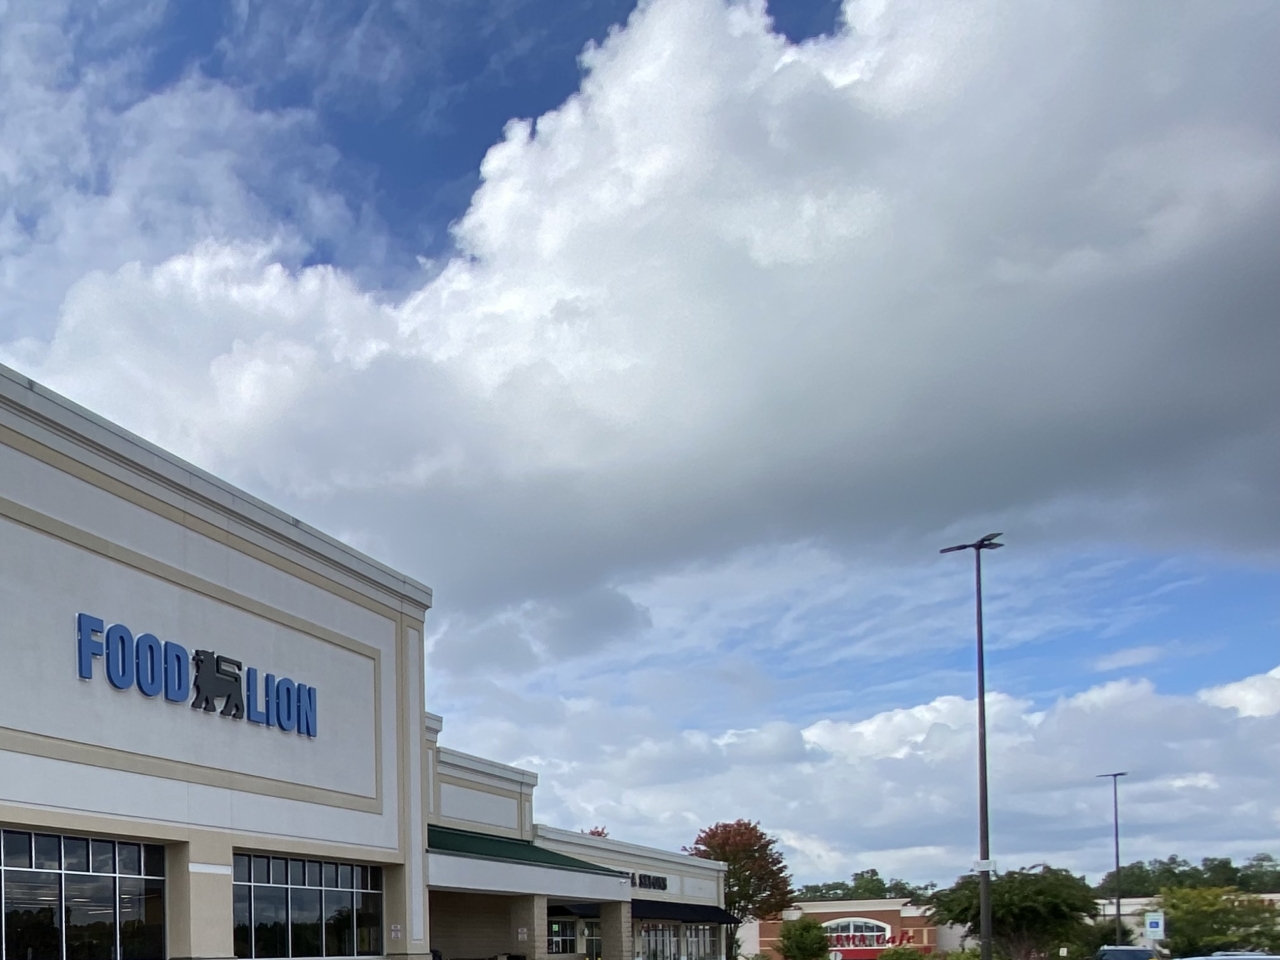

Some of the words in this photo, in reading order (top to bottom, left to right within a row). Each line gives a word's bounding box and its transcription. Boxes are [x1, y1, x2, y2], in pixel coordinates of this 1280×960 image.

[75, 612, 190, 703] FOOD
[246, 666, 317, 738] LION
[875, 931, 915, 946] Cafe
